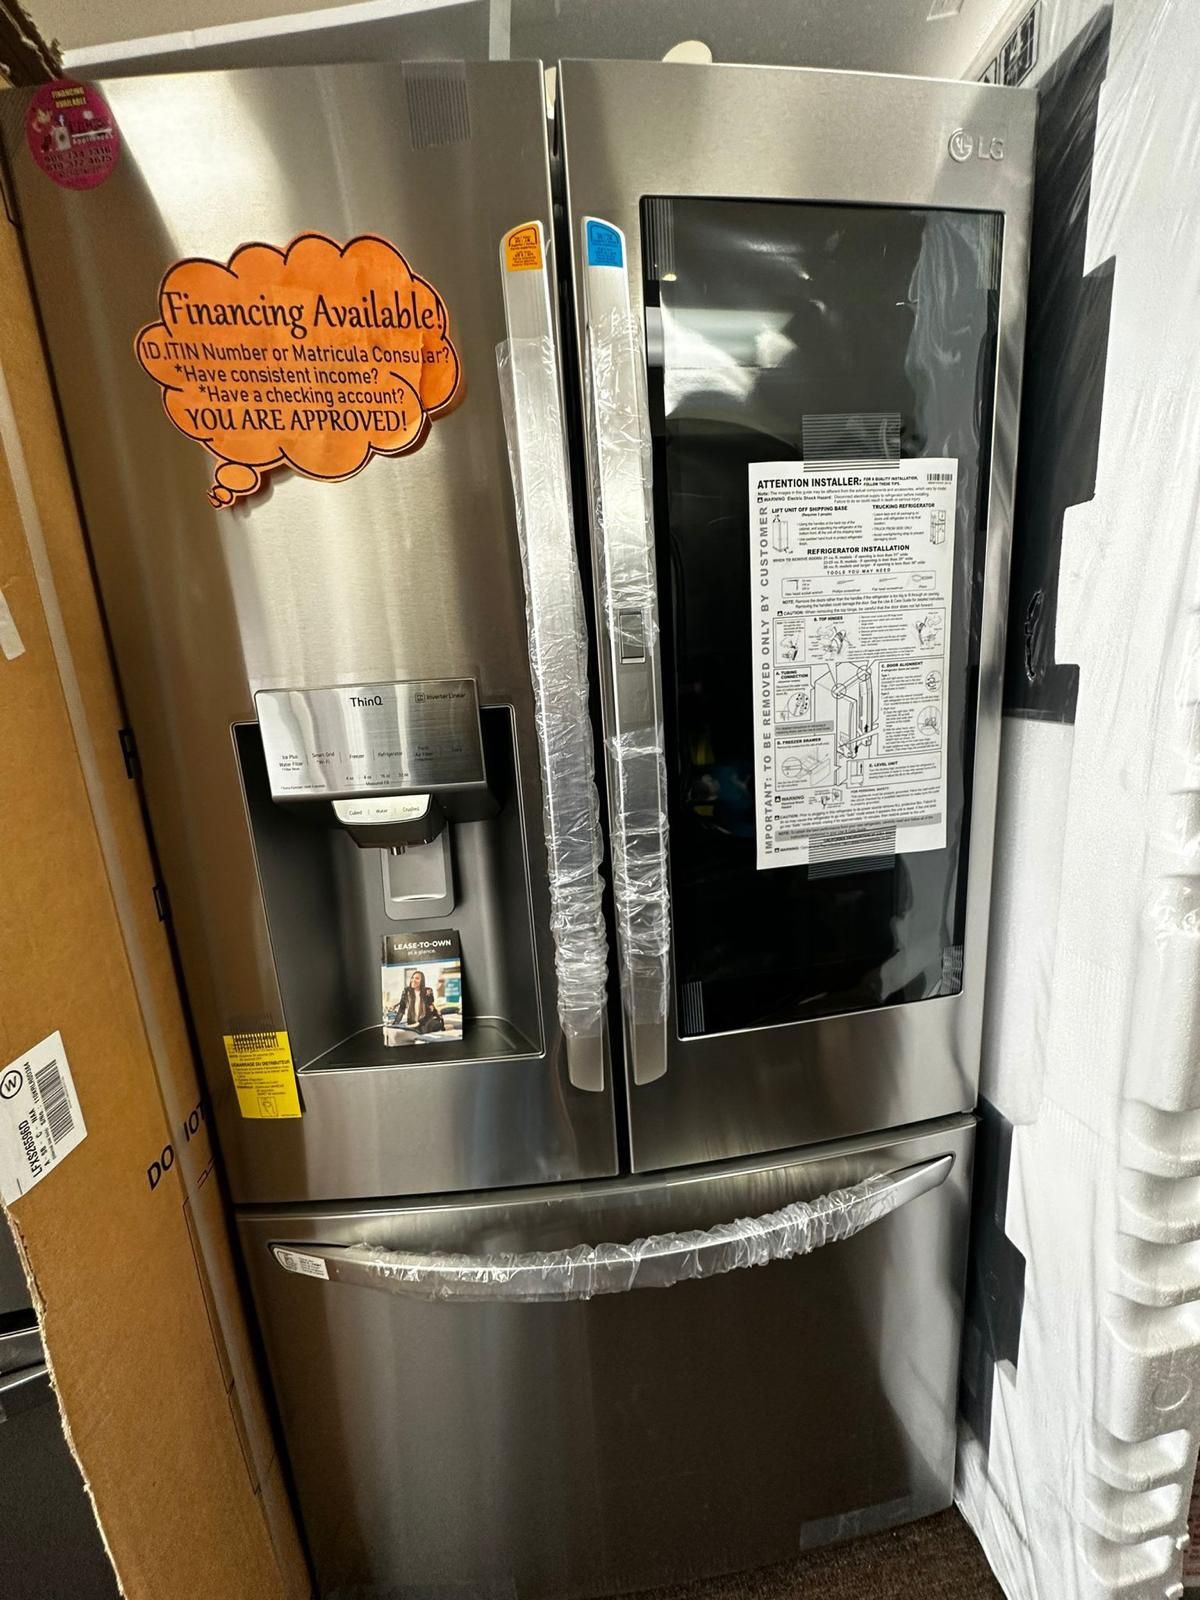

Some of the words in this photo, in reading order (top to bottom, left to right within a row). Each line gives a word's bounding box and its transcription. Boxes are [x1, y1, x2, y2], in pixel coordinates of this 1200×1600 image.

[978, 136, 1004, 160] LG
[162, 291, 307, 339] Financing
[314, 290, 442, 330] Available!
[202, 344, 268, 362] Number
[272, 348, 288, 361] or
[292, 344, 368, 363] Matricula
[372, 346, 450, 364] Consular?
[231, 367, 311, 384] consistent
[314, 367, 378, 384] income?
[253, 390, 262, 402] a
[266, 386, 334, 406] checking
[338, 388, 404, 404] account?
[184, 408, 239, 431] YOU
[242, 409, 286, 431] ARE
[290, 409, 408, 432] APPROVED!
[757, 479, 809, 489] ATTENTION
[811, 477, 862, 487] INSTALLER:
[759, 506, 768, 587] CUSTOMER
[761, 594, 769, 612] BY
[761, 620, 770, 655] ONLY
[350, 695, 384, 707] ThinQ
[762, 662, 771, 725] REMOVED
[763, 732, 771, 748] BE
[764, 755, 772, 772] TO
[764, 777, 773, 854] IMPORTANT:
[394, 940, 452, 950] LEASE-TO-OWN
[18, 1120, 43, 1178] LFXS26596D
[147, 1144, 174, 1191] DO
